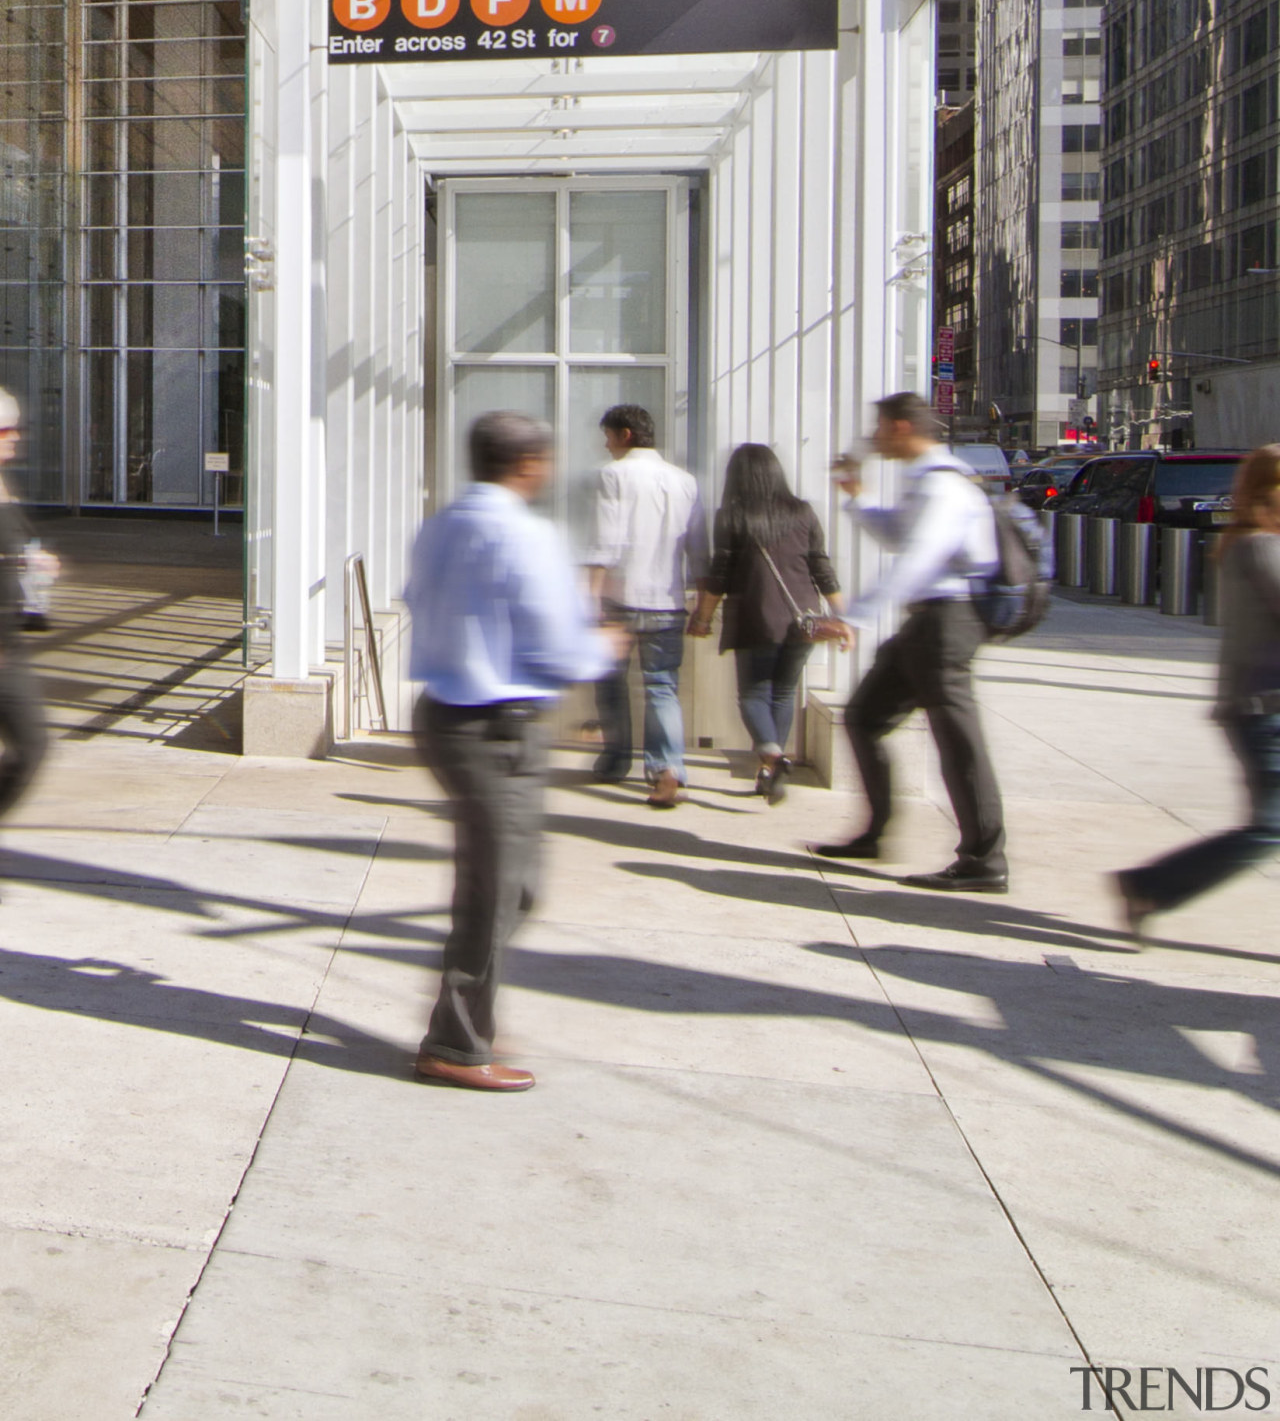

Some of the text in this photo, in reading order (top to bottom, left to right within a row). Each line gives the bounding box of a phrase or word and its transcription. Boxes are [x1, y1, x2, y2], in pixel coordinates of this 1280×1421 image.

[329, 28, 610, 54] Enter across 42 St for 7
